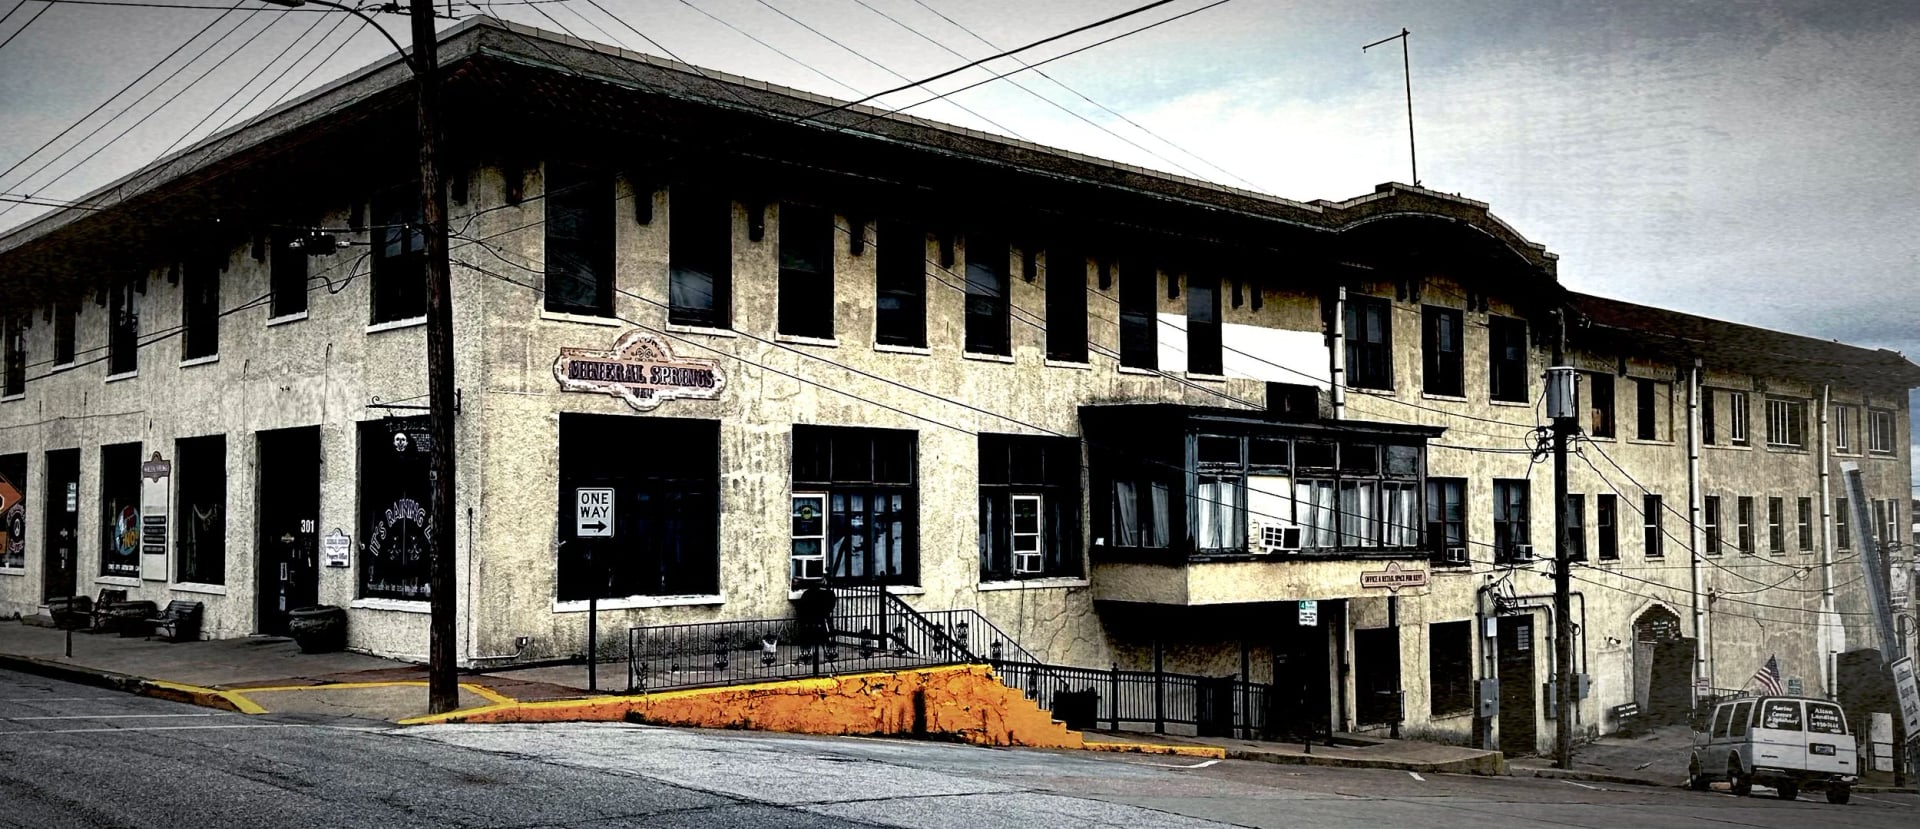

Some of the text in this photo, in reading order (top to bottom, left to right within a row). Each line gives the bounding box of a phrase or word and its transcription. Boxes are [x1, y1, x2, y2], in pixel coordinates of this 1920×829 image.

[568, 360, 715, 388] MINERAL SPRINGS
[581, 492, 609, 505] ONE
[385, 498, 426, 529] RAINING
[580, 506, 610, 518] WAY
[301, 519, 315, 533] 301
[1811, 713, 1839, 722] Landing
